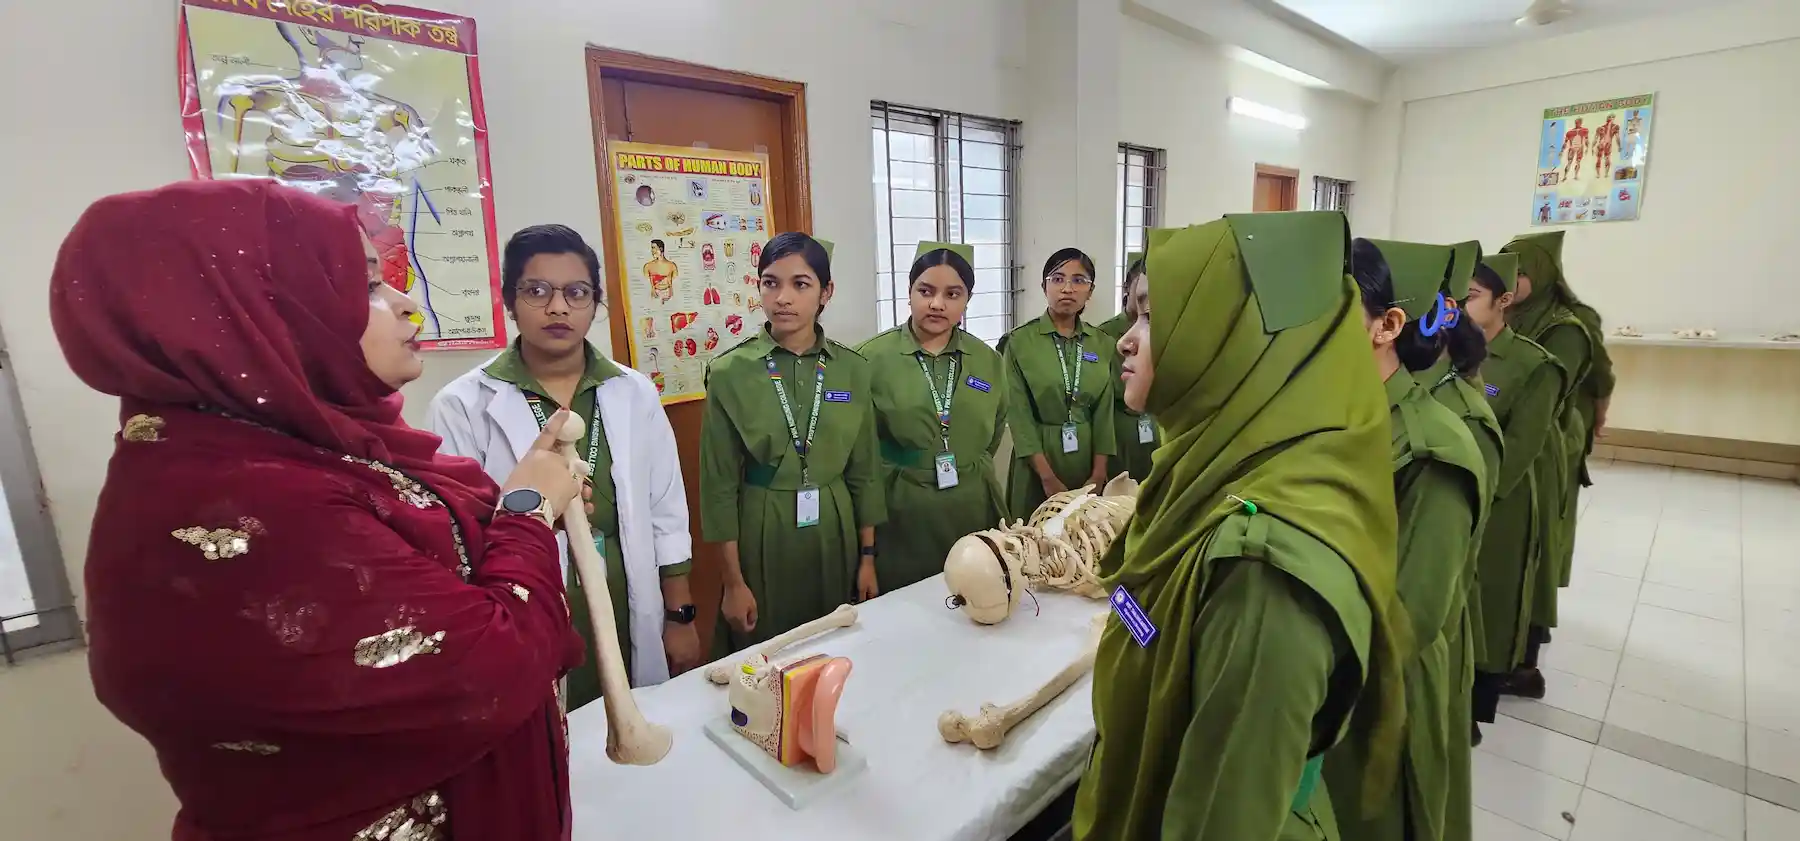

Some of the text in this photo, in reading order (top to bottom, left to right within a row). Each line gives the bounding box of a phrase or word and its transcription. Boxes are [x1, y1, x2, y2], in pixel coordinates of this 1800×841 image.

[343, 4, 423, 38] পরিপাক
[427, 24, 459, 48] তন্ত্র
[618, 153, 761, 177] PARTS OF HUMAN BODY
[775, 379, 787, 404] COLLEGE
[531, 402, 548, 427] OLLEGE
[807, 416, 817, 440] COLLEGE
[587, 446, 598, 476] COLLEGE
